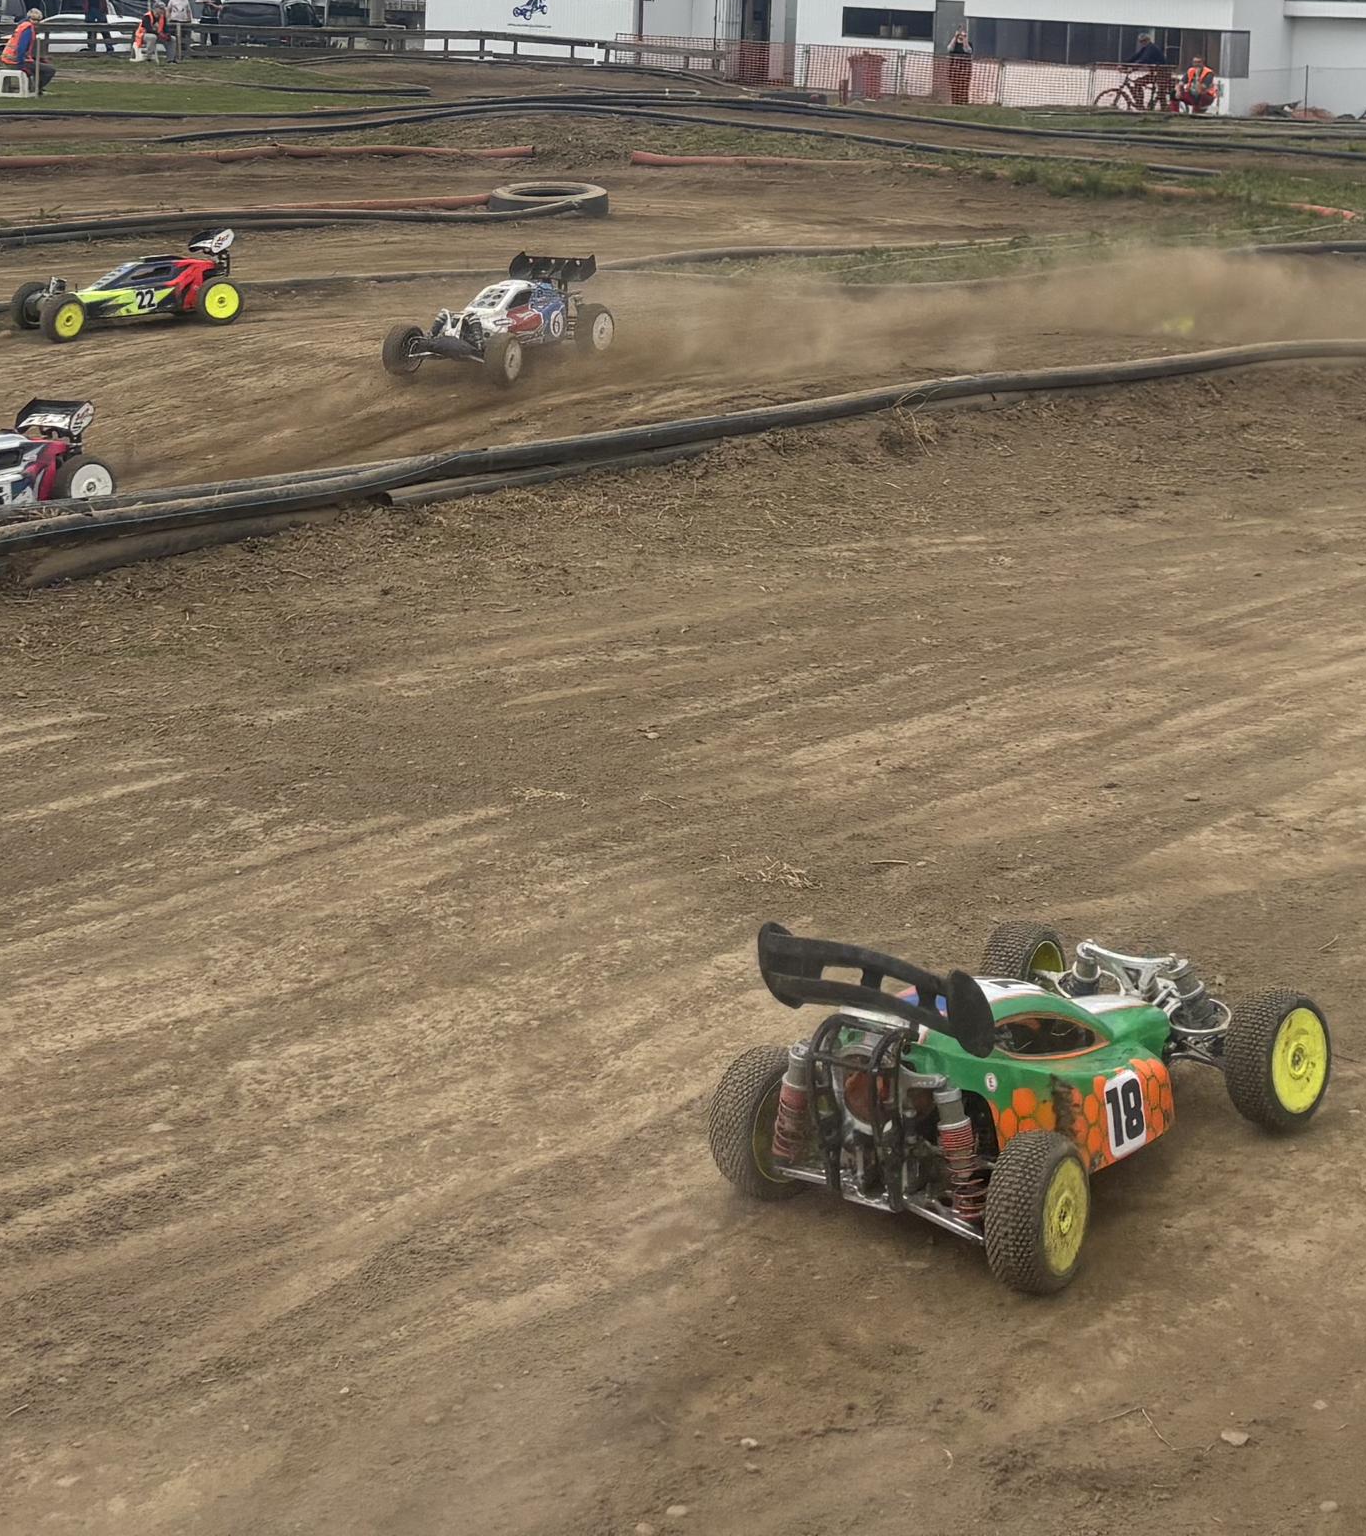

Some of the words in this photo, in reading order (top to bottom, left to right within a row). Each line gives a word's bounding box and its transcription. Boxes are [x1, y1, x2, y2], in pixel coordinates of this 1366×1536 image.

[135, 288, 156, 310] 22
[552, 313, 561, 334] 6
[1105, 1077, 1145, 1148] 18
